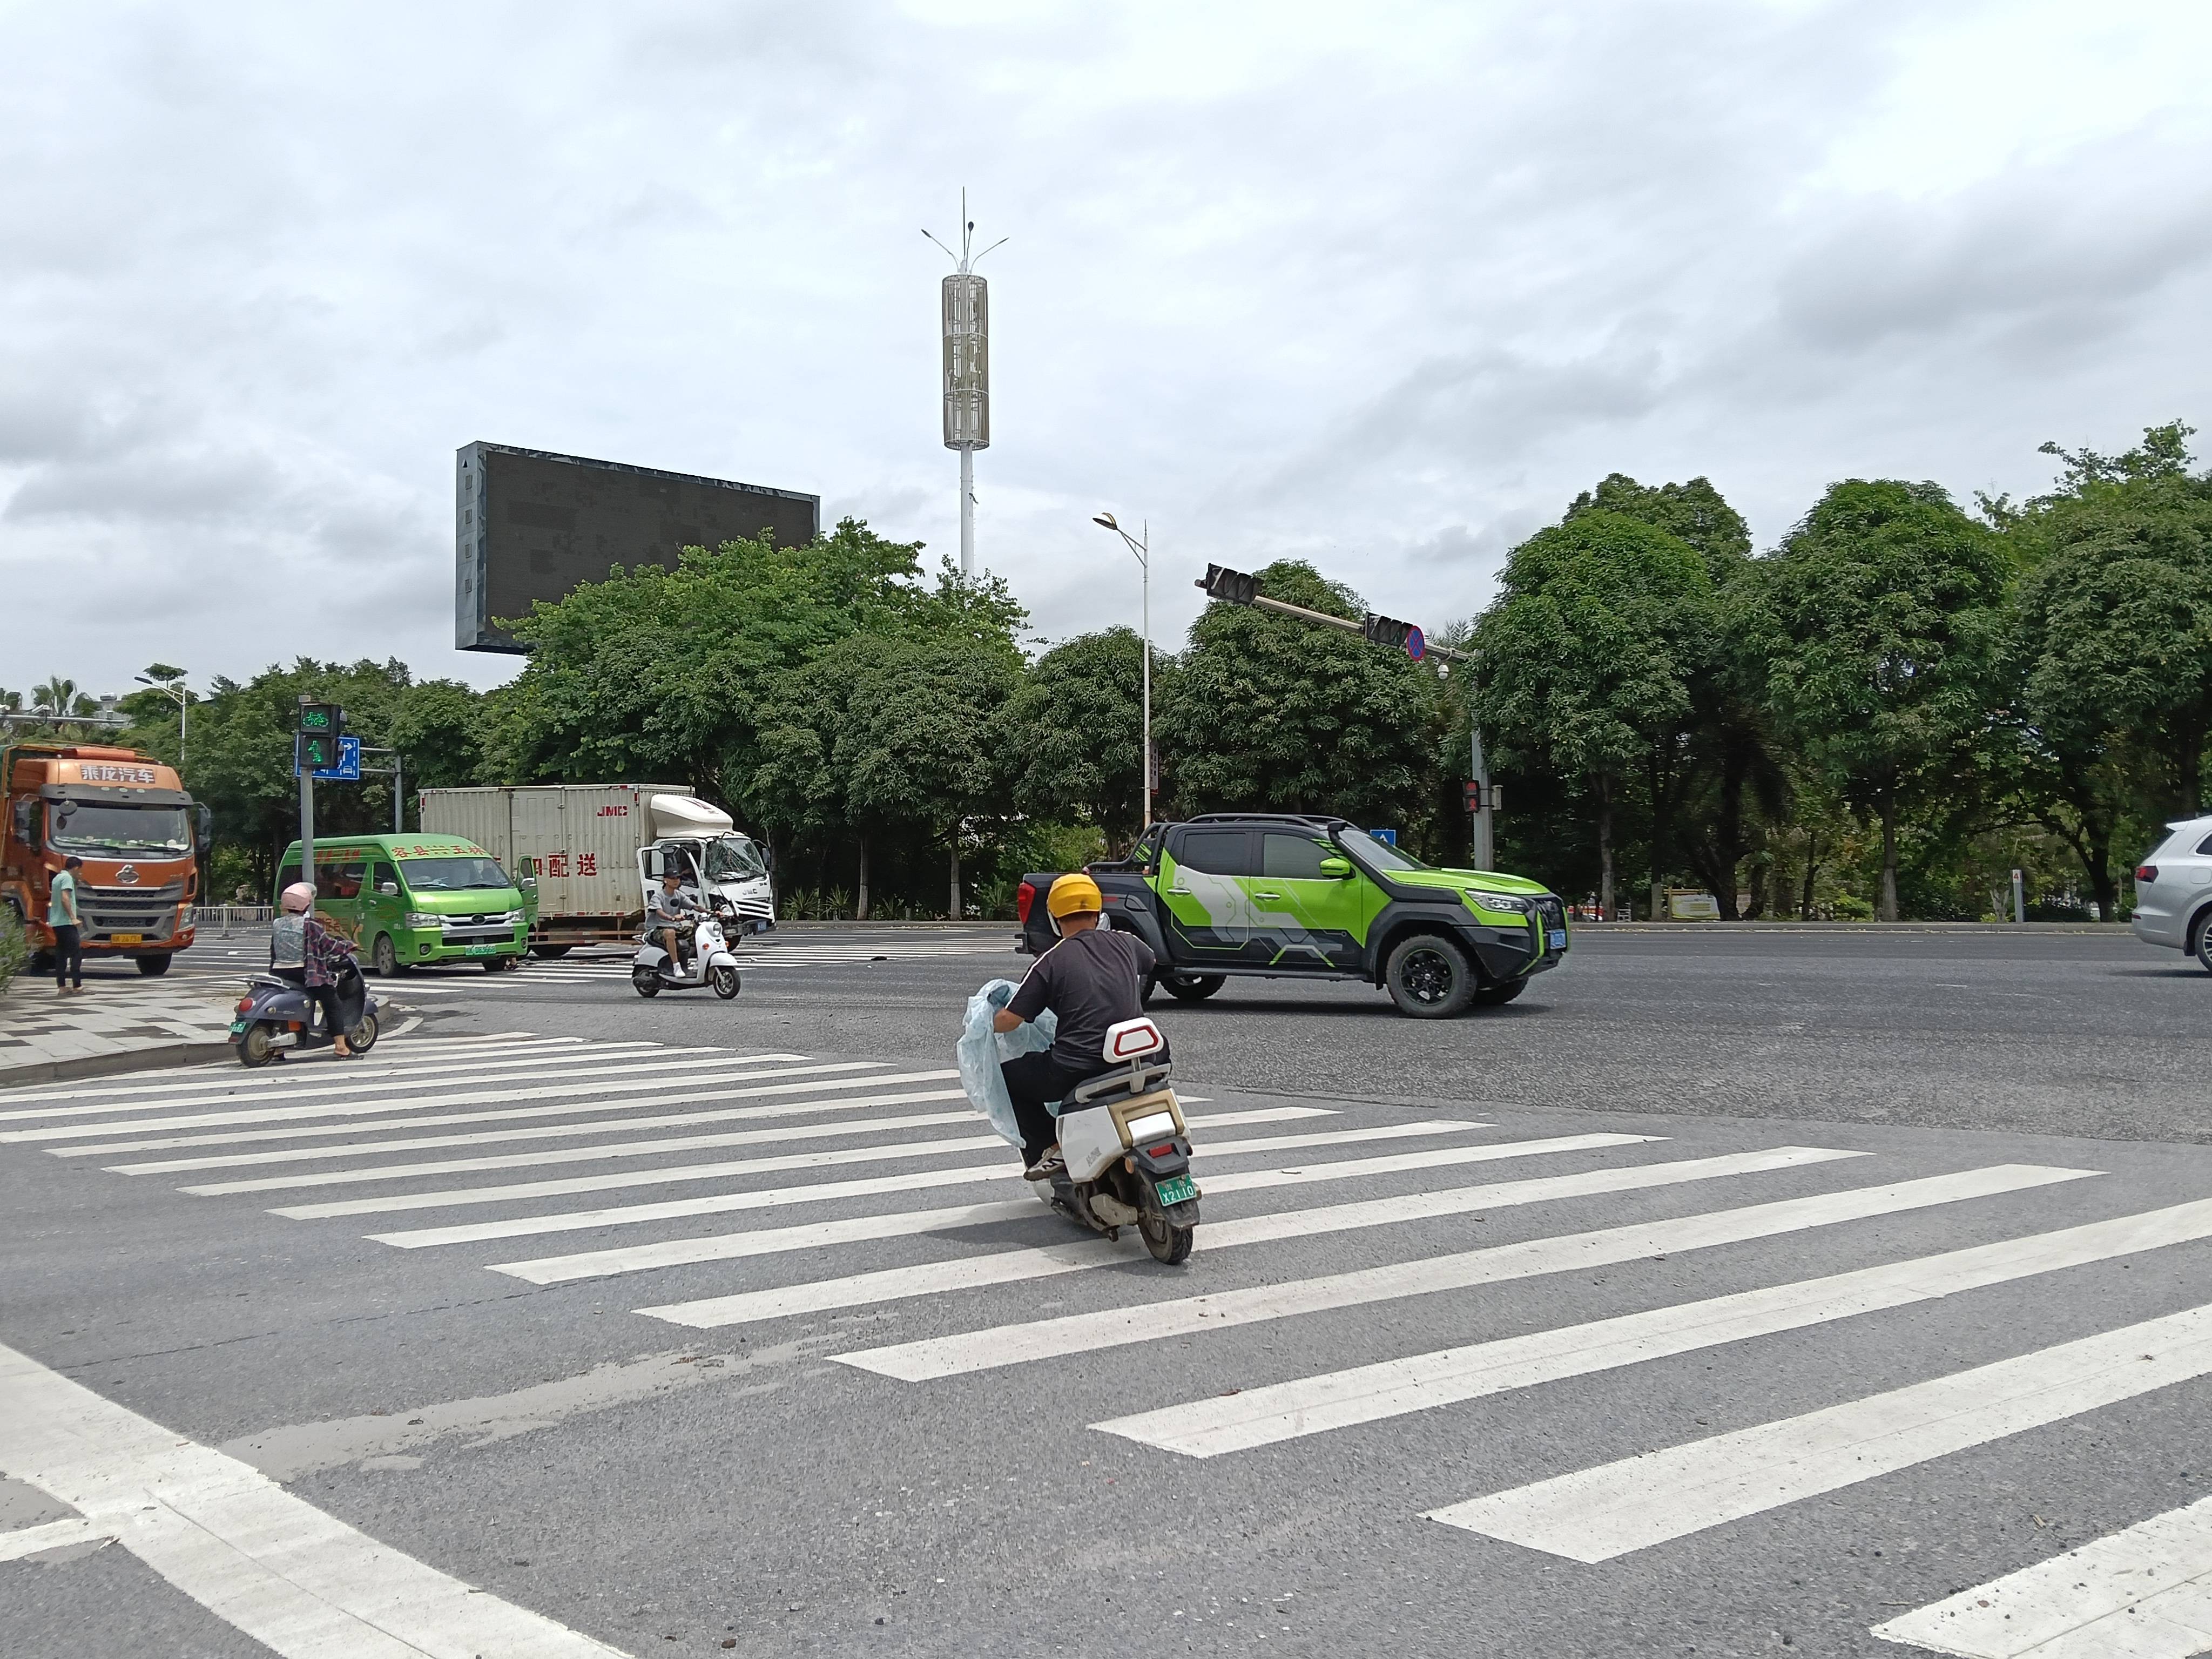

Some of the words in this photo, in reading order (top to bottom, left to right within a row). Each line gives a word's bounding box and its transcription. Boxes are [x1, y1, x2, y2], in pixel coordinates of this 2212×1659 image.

[81, 765, 155, 783] 乘龙汽车
[597, 806, 628, 816] JMC
[1163, 1185, 1195, 1203] X2110
